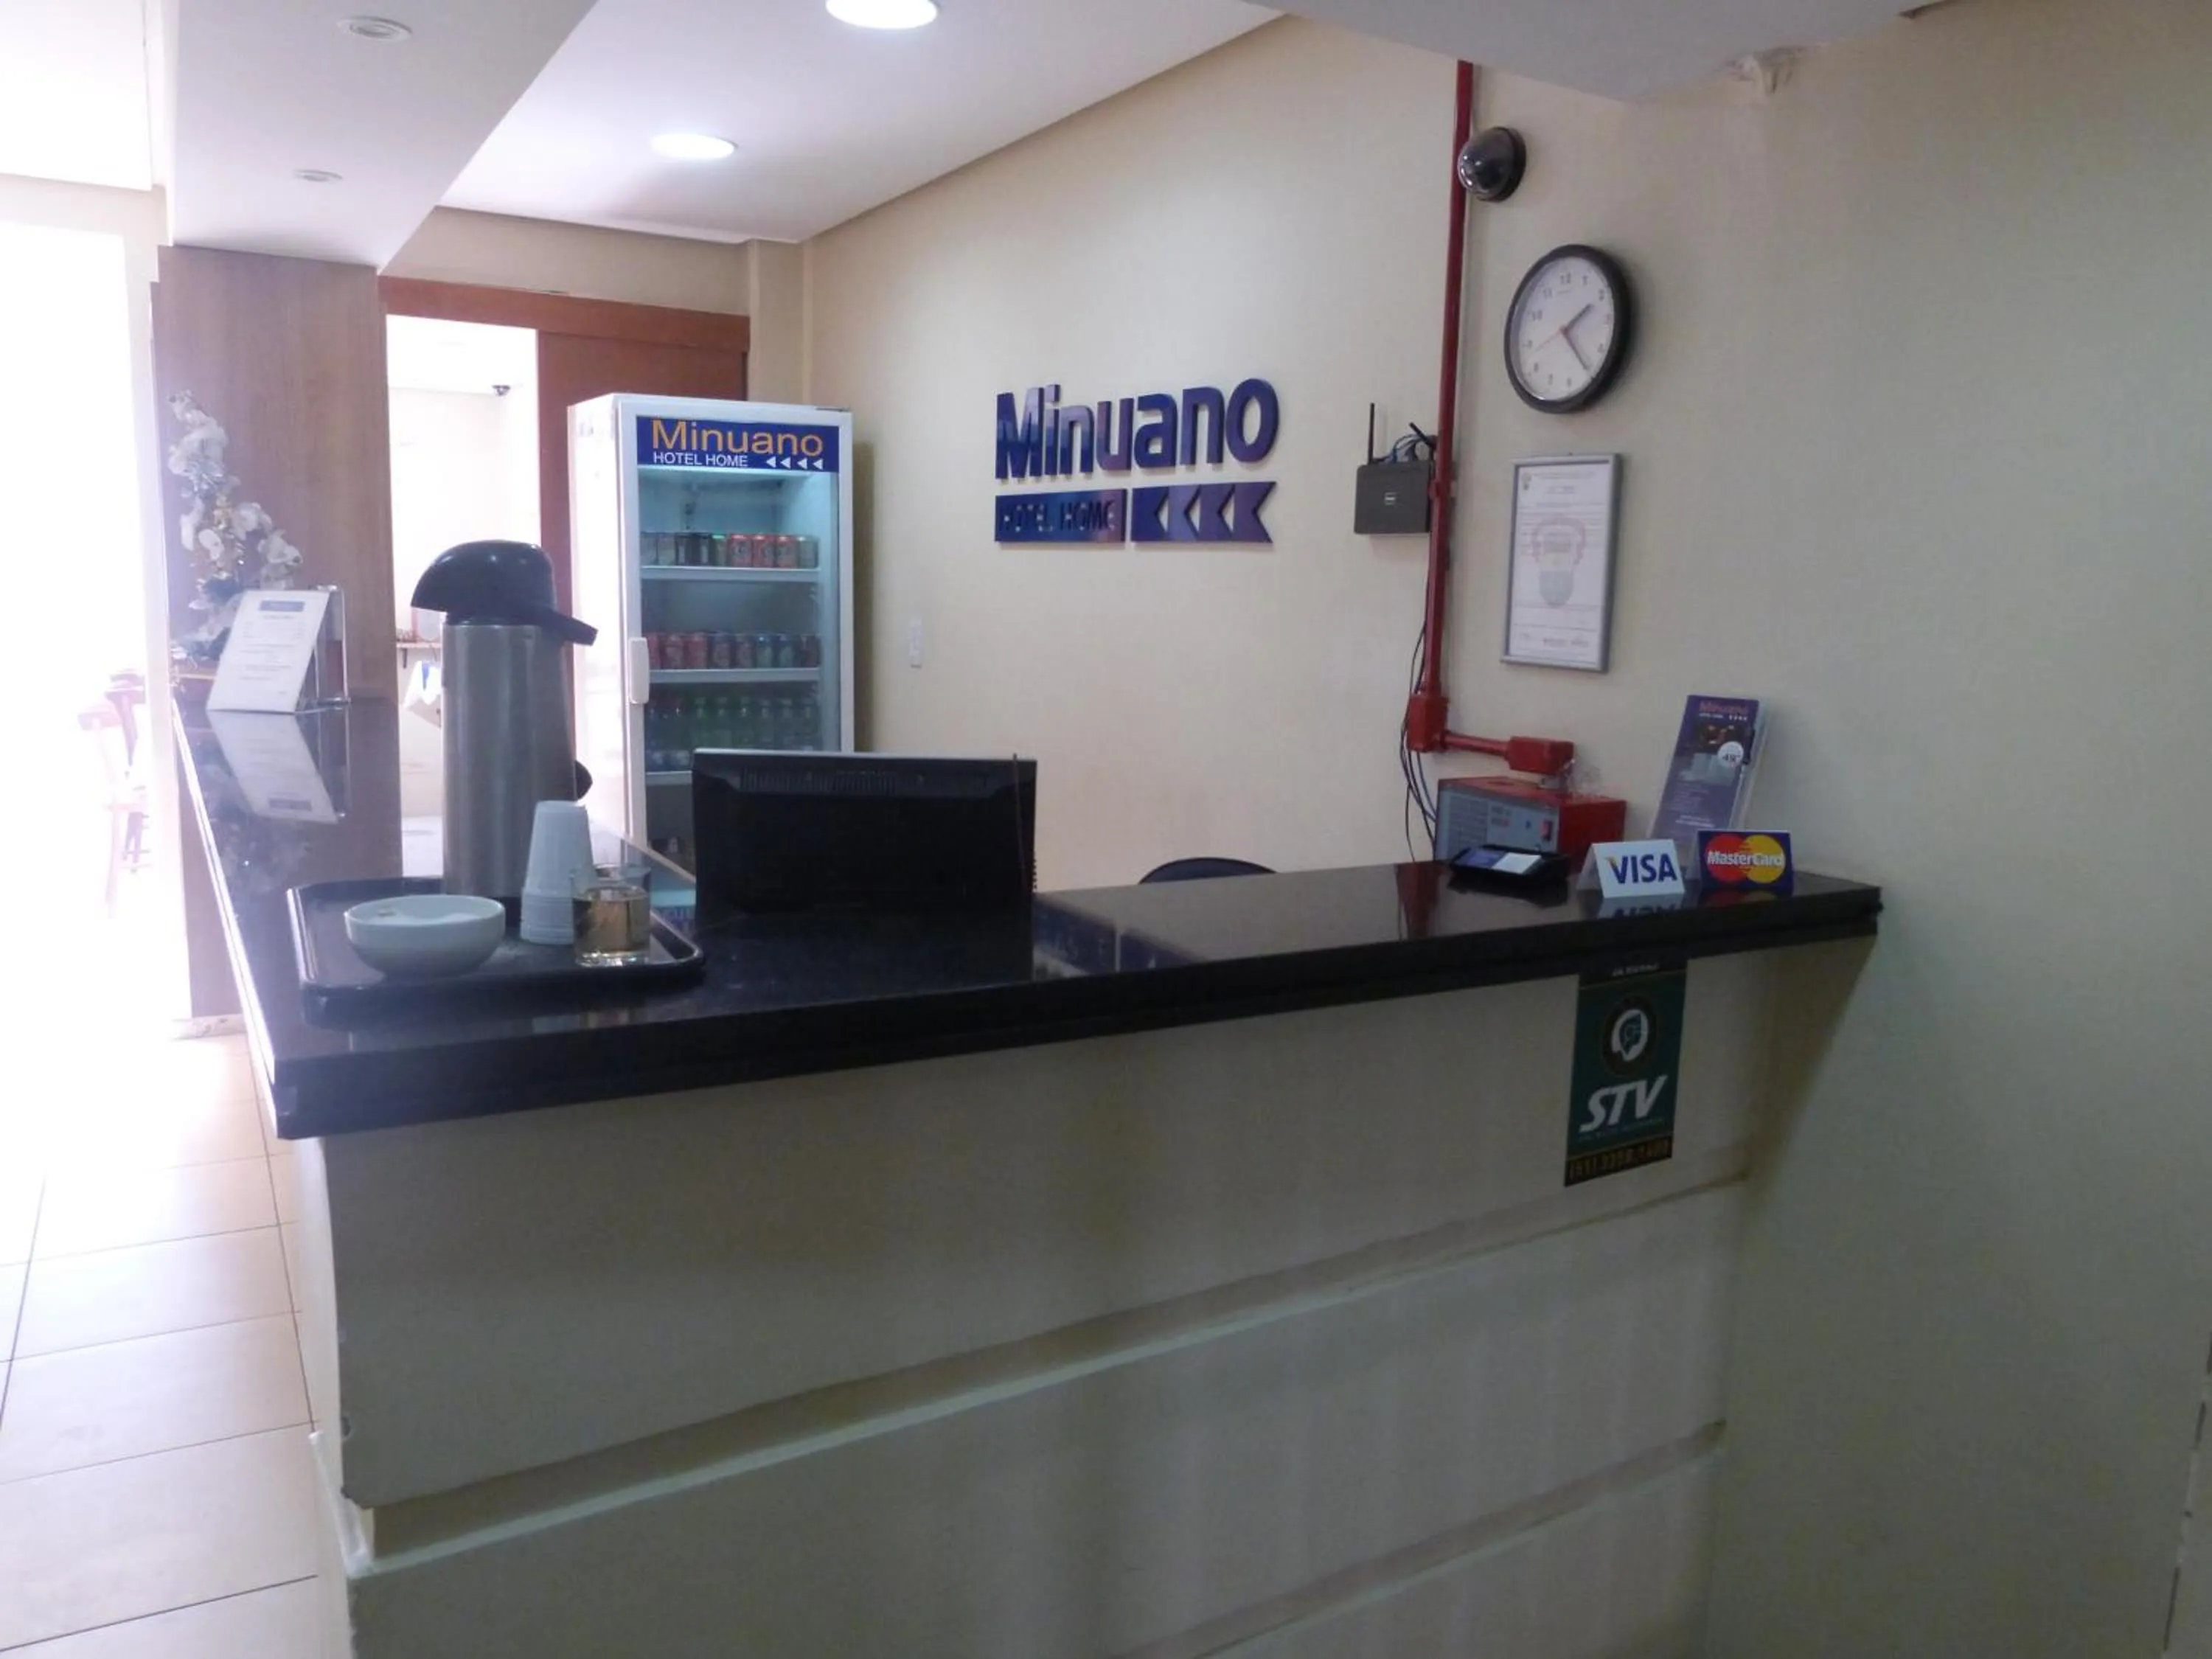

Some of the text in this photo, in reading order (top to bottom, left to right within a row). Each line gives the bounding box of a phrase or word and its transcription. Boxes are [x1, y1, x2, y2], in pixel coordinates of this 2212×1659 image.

[651, 419, 824, 456] Minuano
[995, 378, 1279, 479] Minuano
[653, 452, 748, 467] HOTEL HOME
[1607, 853, 1677, 885] VISA
[1707, 850, 1785, 866] MasterCard
[1579, 1074, 1669, 1133] STV
